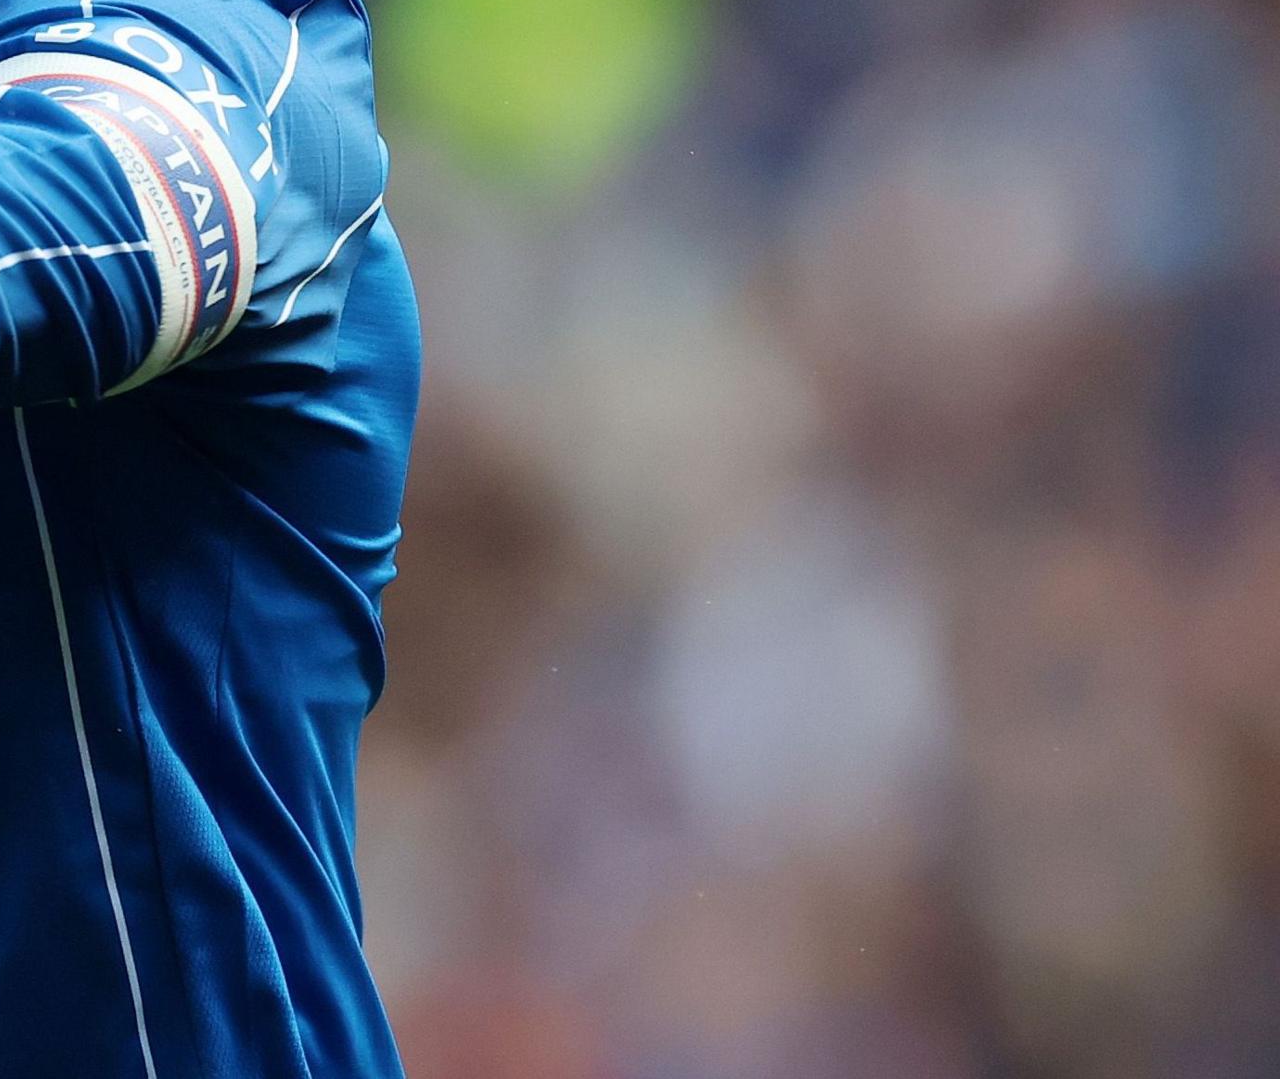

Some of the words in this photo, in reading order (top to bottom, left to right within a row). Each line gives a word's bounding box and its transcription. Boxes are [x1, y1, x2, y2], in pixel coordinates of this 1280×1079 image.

[40, 85, 229, 308] CAPTAIN
[113, 137, 174, 228] FOOTBALL
[172, 235, 190, 290] CLUB
